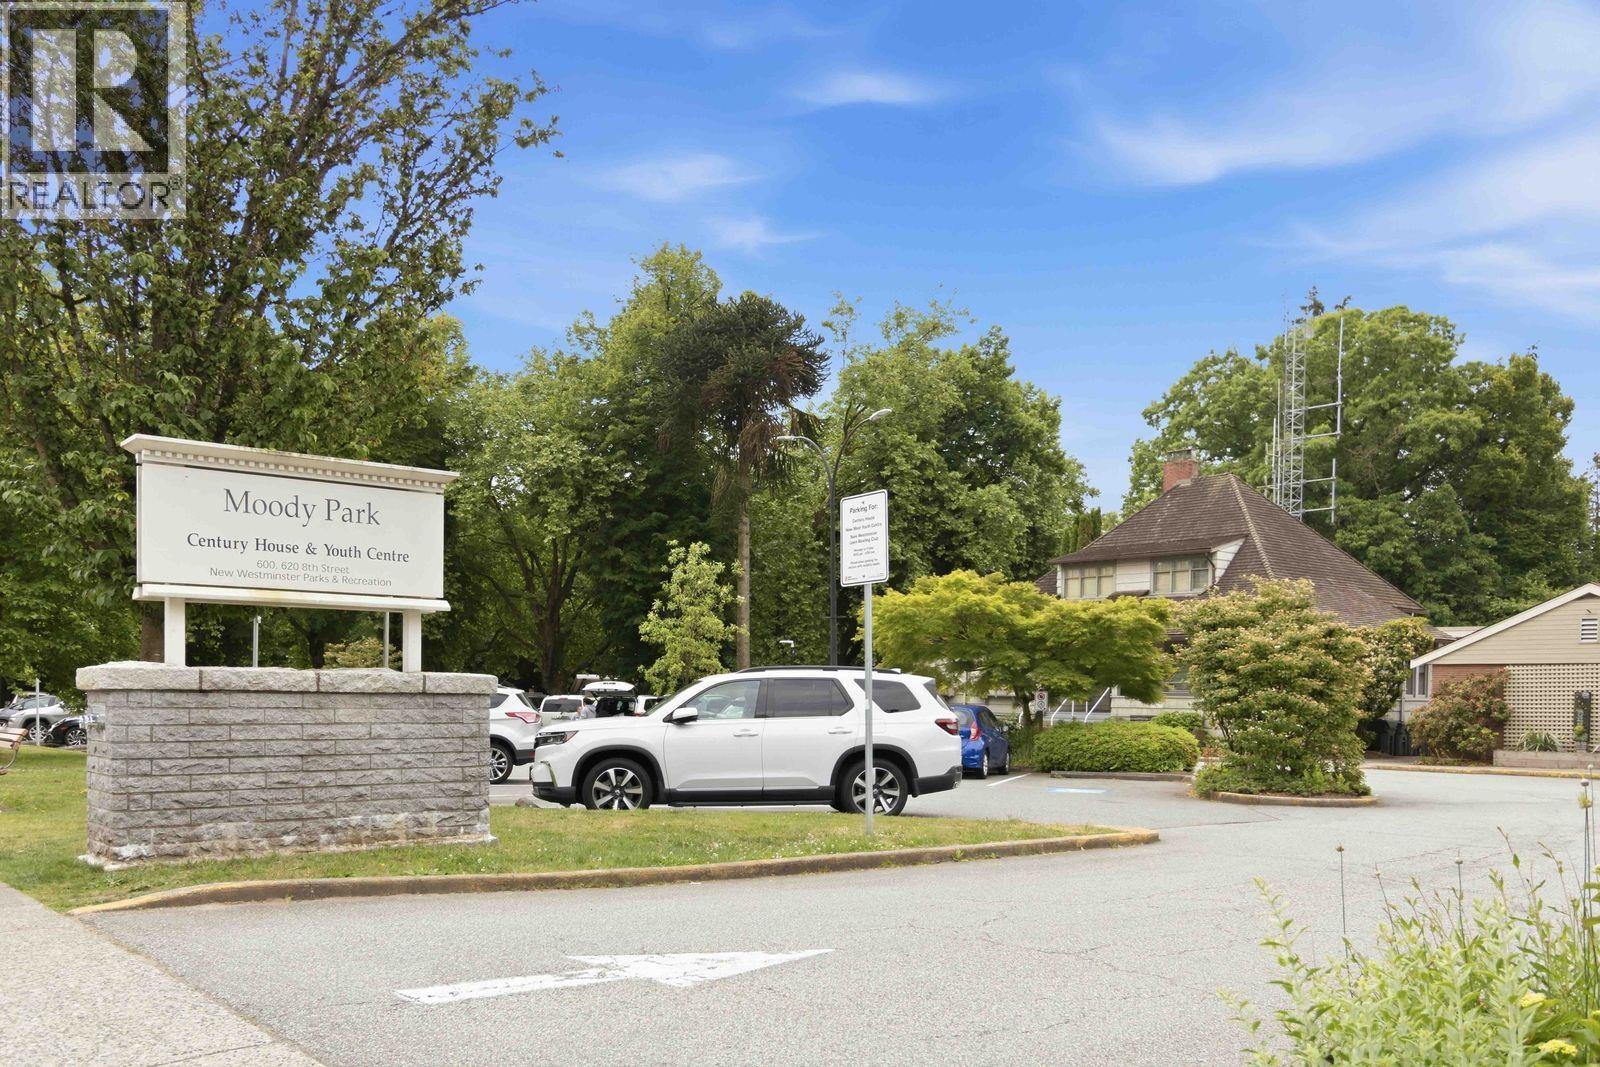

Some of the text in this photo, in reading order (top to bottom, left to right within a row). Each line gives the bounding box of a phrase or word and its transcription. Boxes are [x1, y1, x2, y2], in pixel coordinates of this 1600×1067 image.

[223, 488, 381, 527] Moody Park
[849, 506, 868, 514] Parking
[187, 532, 409, 562] Century House & Youth Centre
[281, 561, 299, 571] 620
[302, 562, 318, 572] 8th
[321, 564, 349, 574] Street
[210, 568, 391, 587] New Westminster Parks & Recreation
